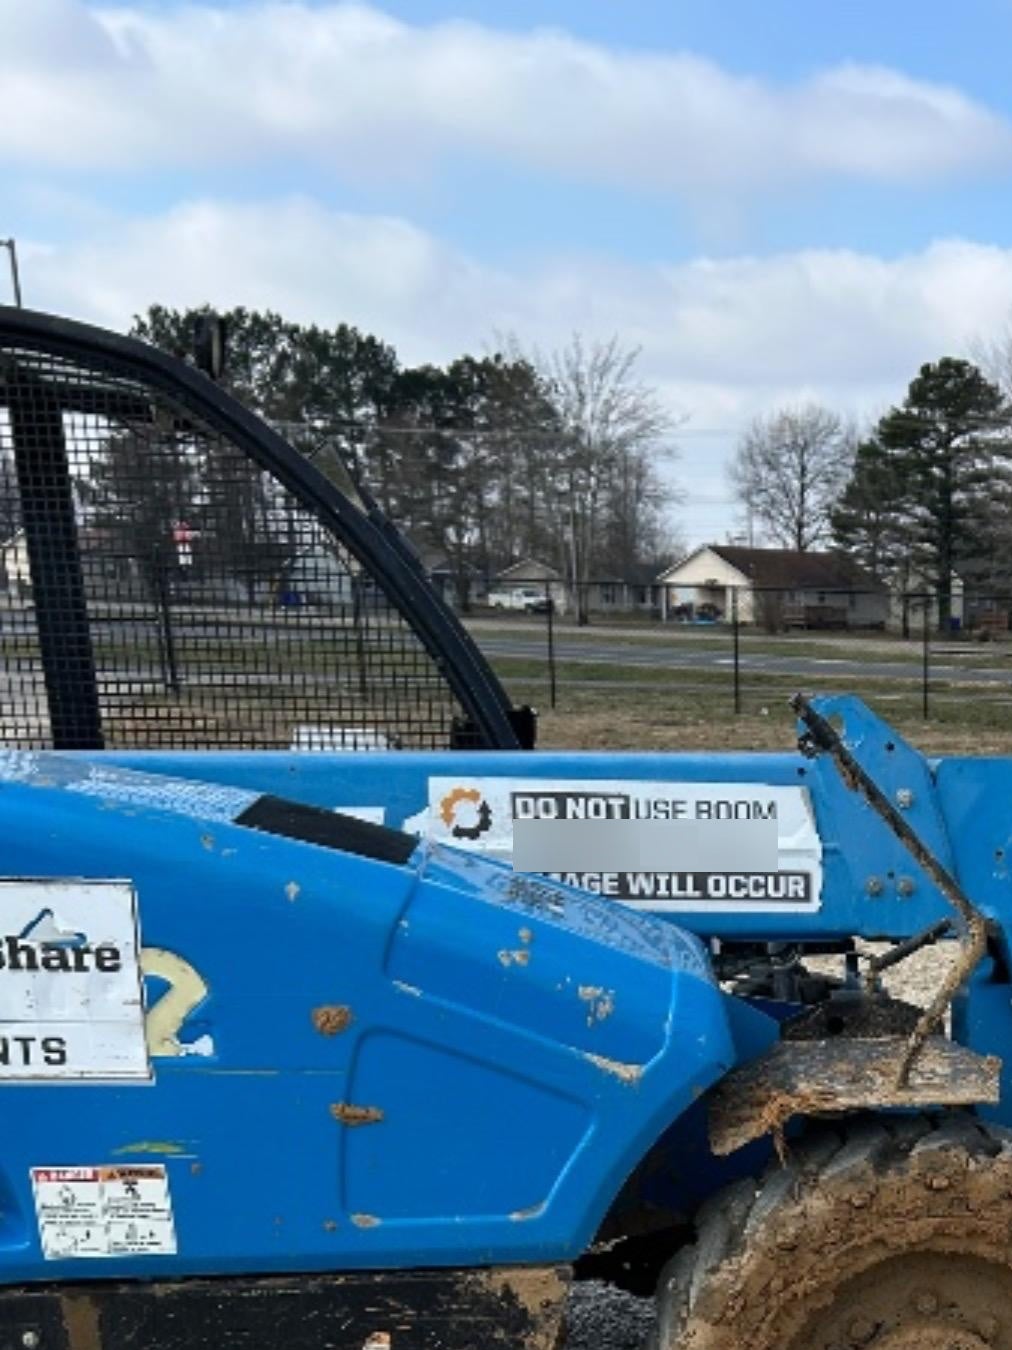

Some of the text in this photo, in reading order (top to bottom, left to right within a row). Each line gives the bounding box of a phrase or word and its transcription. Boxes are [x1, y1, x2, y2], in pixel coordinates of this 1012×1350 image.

[514, 796, 558, 819] DO
[566, 797, 626, 819] NOT
[635, 800, 687, 819] USE
[626, 872, 702, 896] WILL
[707, 874, 806, 898] OCCUR
